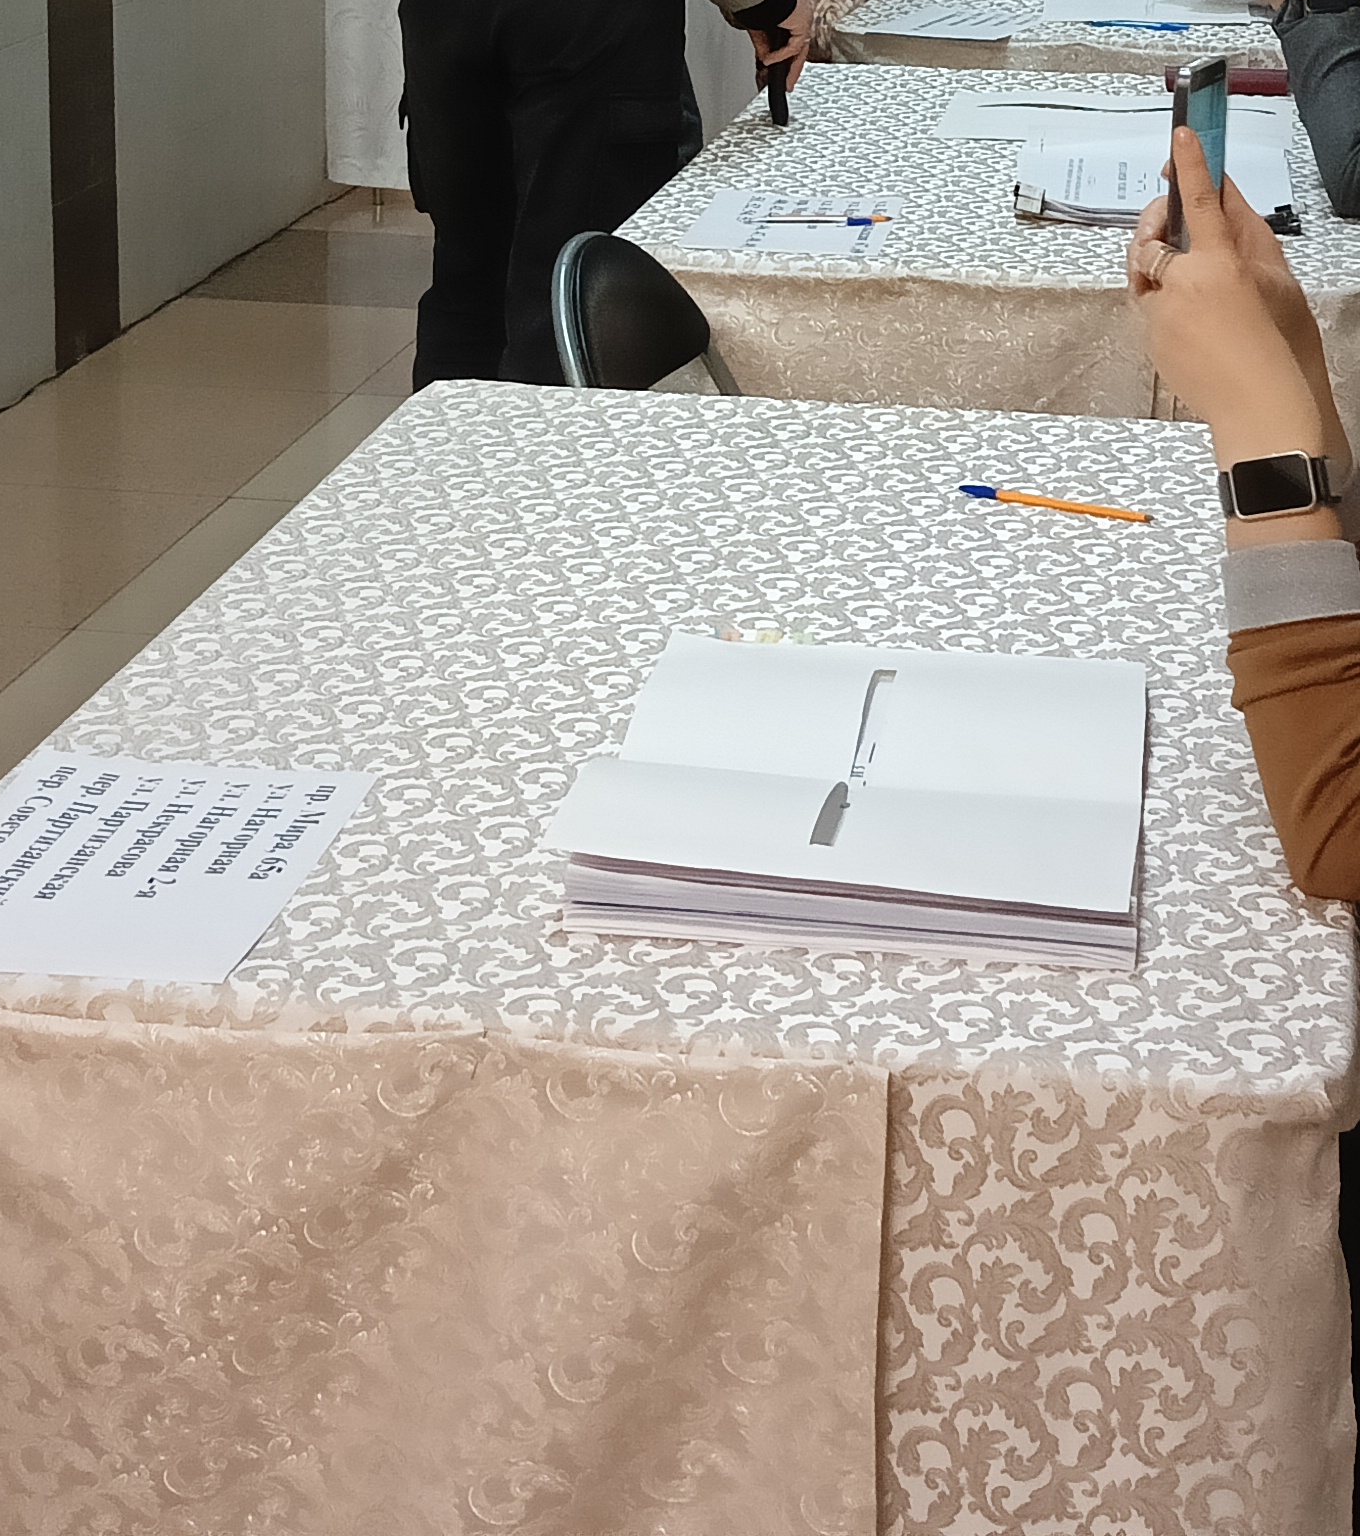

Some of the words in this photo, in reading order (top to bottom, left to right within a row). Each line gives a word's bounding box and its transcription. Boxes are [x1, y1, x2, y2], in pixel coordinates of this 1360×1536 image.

[37, 766, 78, 791] пер.
[80, 772, 121, 798] пер.
[131, 776, 164, 796] ул.
[174, 779, 207, 799] ул.
[219, 781, 250, 802] ул.
[263, 783, 295, 804] ул.
[304, 785, 337, 805] пр.
[105, 803, 194, 878] Некрасова
[157, 806, 239, 873] Нагорная
[204, 808, 283, 875] Нагорная
[265, 809, 327, 853] Мира,
[33, 800, 151, 900] Партизанская
[134, 876, 177, 899] 2-я
